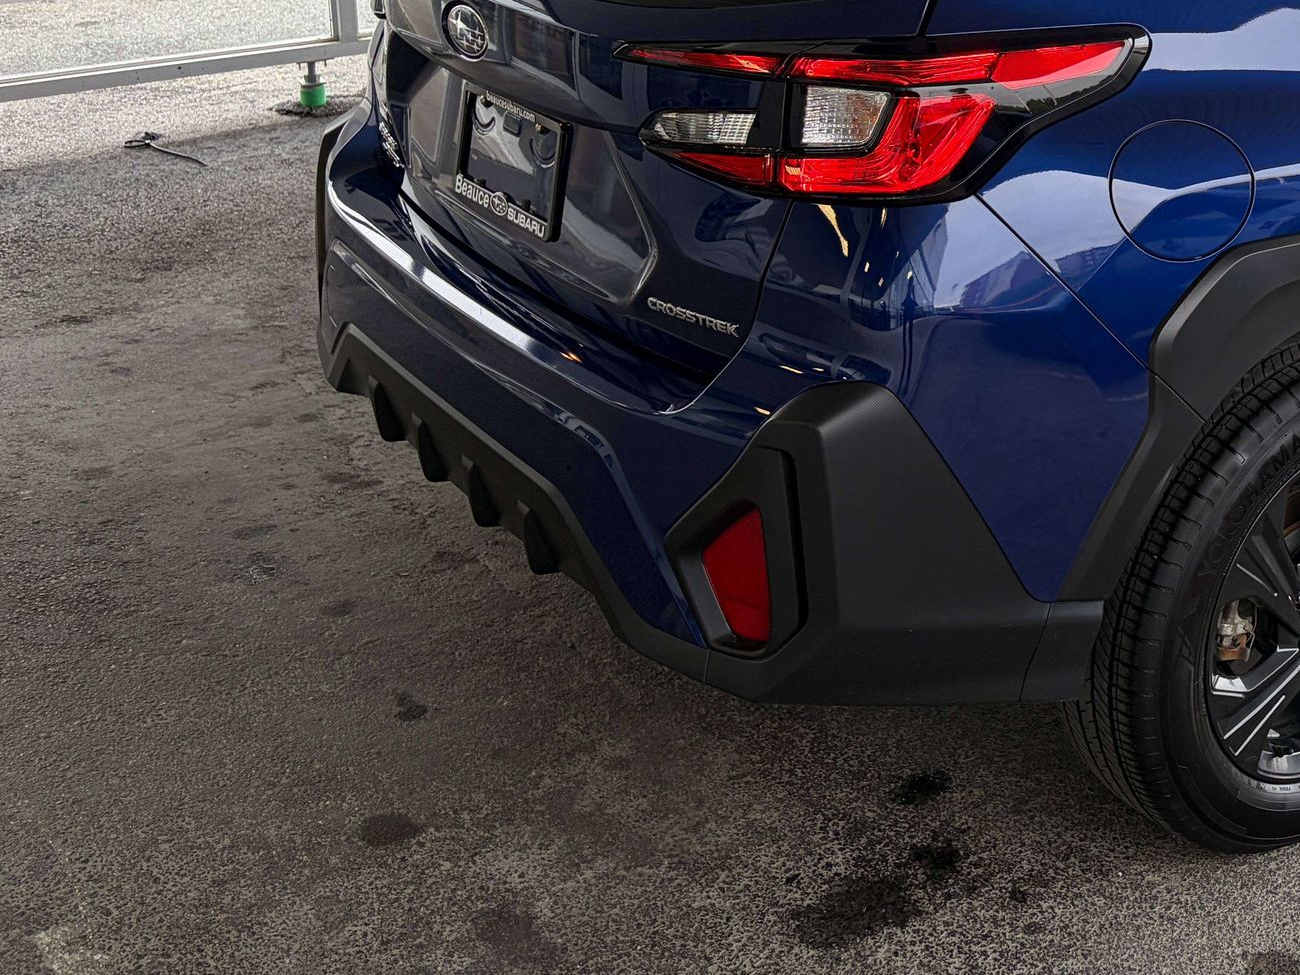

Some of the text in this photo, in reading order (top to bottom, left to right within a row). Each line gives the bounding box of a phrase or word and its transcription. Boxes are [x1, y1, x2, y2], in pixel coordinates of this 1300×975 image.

[486, 91, 536, 122] beaucesubaru.com
[455, 174, 545, 237] Beauce SUBARU
[647, 296, 739, 338] CROSSTREK
